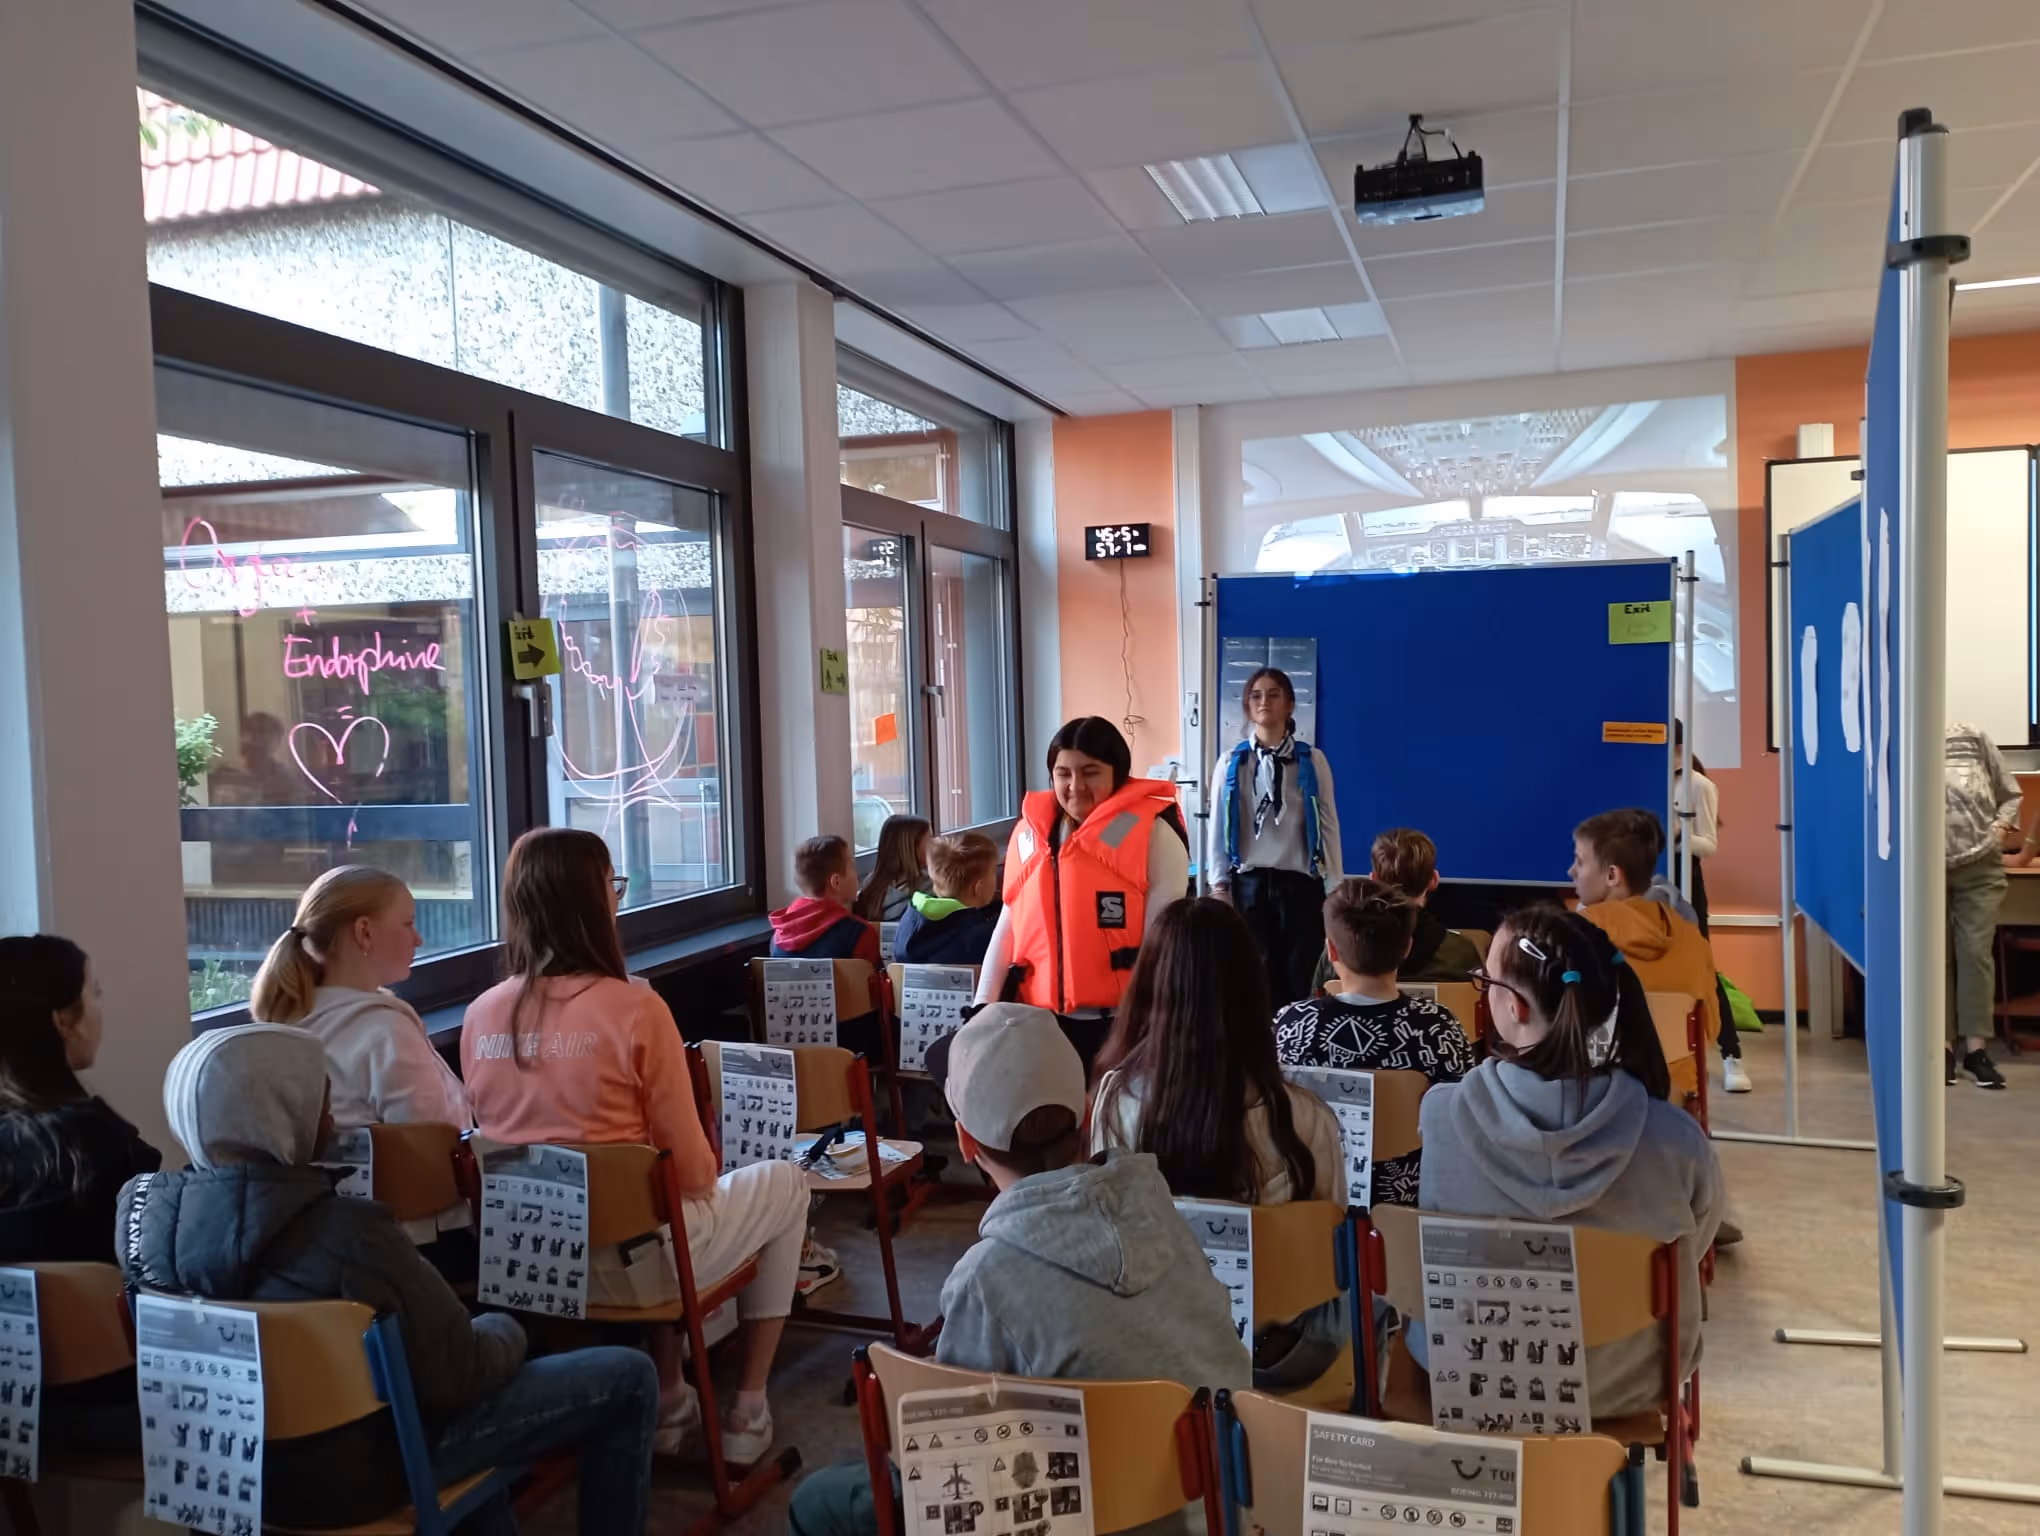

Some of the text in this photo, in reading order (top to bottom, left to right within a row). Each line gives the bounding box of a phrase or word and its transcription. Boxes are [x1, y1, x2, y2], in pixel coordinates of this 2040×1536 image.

[1624, 603, 1651, 614] Exit
[283, 631, 447, 695] Endorphine
[542, 1032, 597, 1059] AIR
[1231, 1226, 1248, 1236] TUI
[1552, 1245, 1571, 1259] TUI
[1313, 1429, 1376, 1448] SAFETY CARD
[1490, 1468, 1515, 1482] TUI
